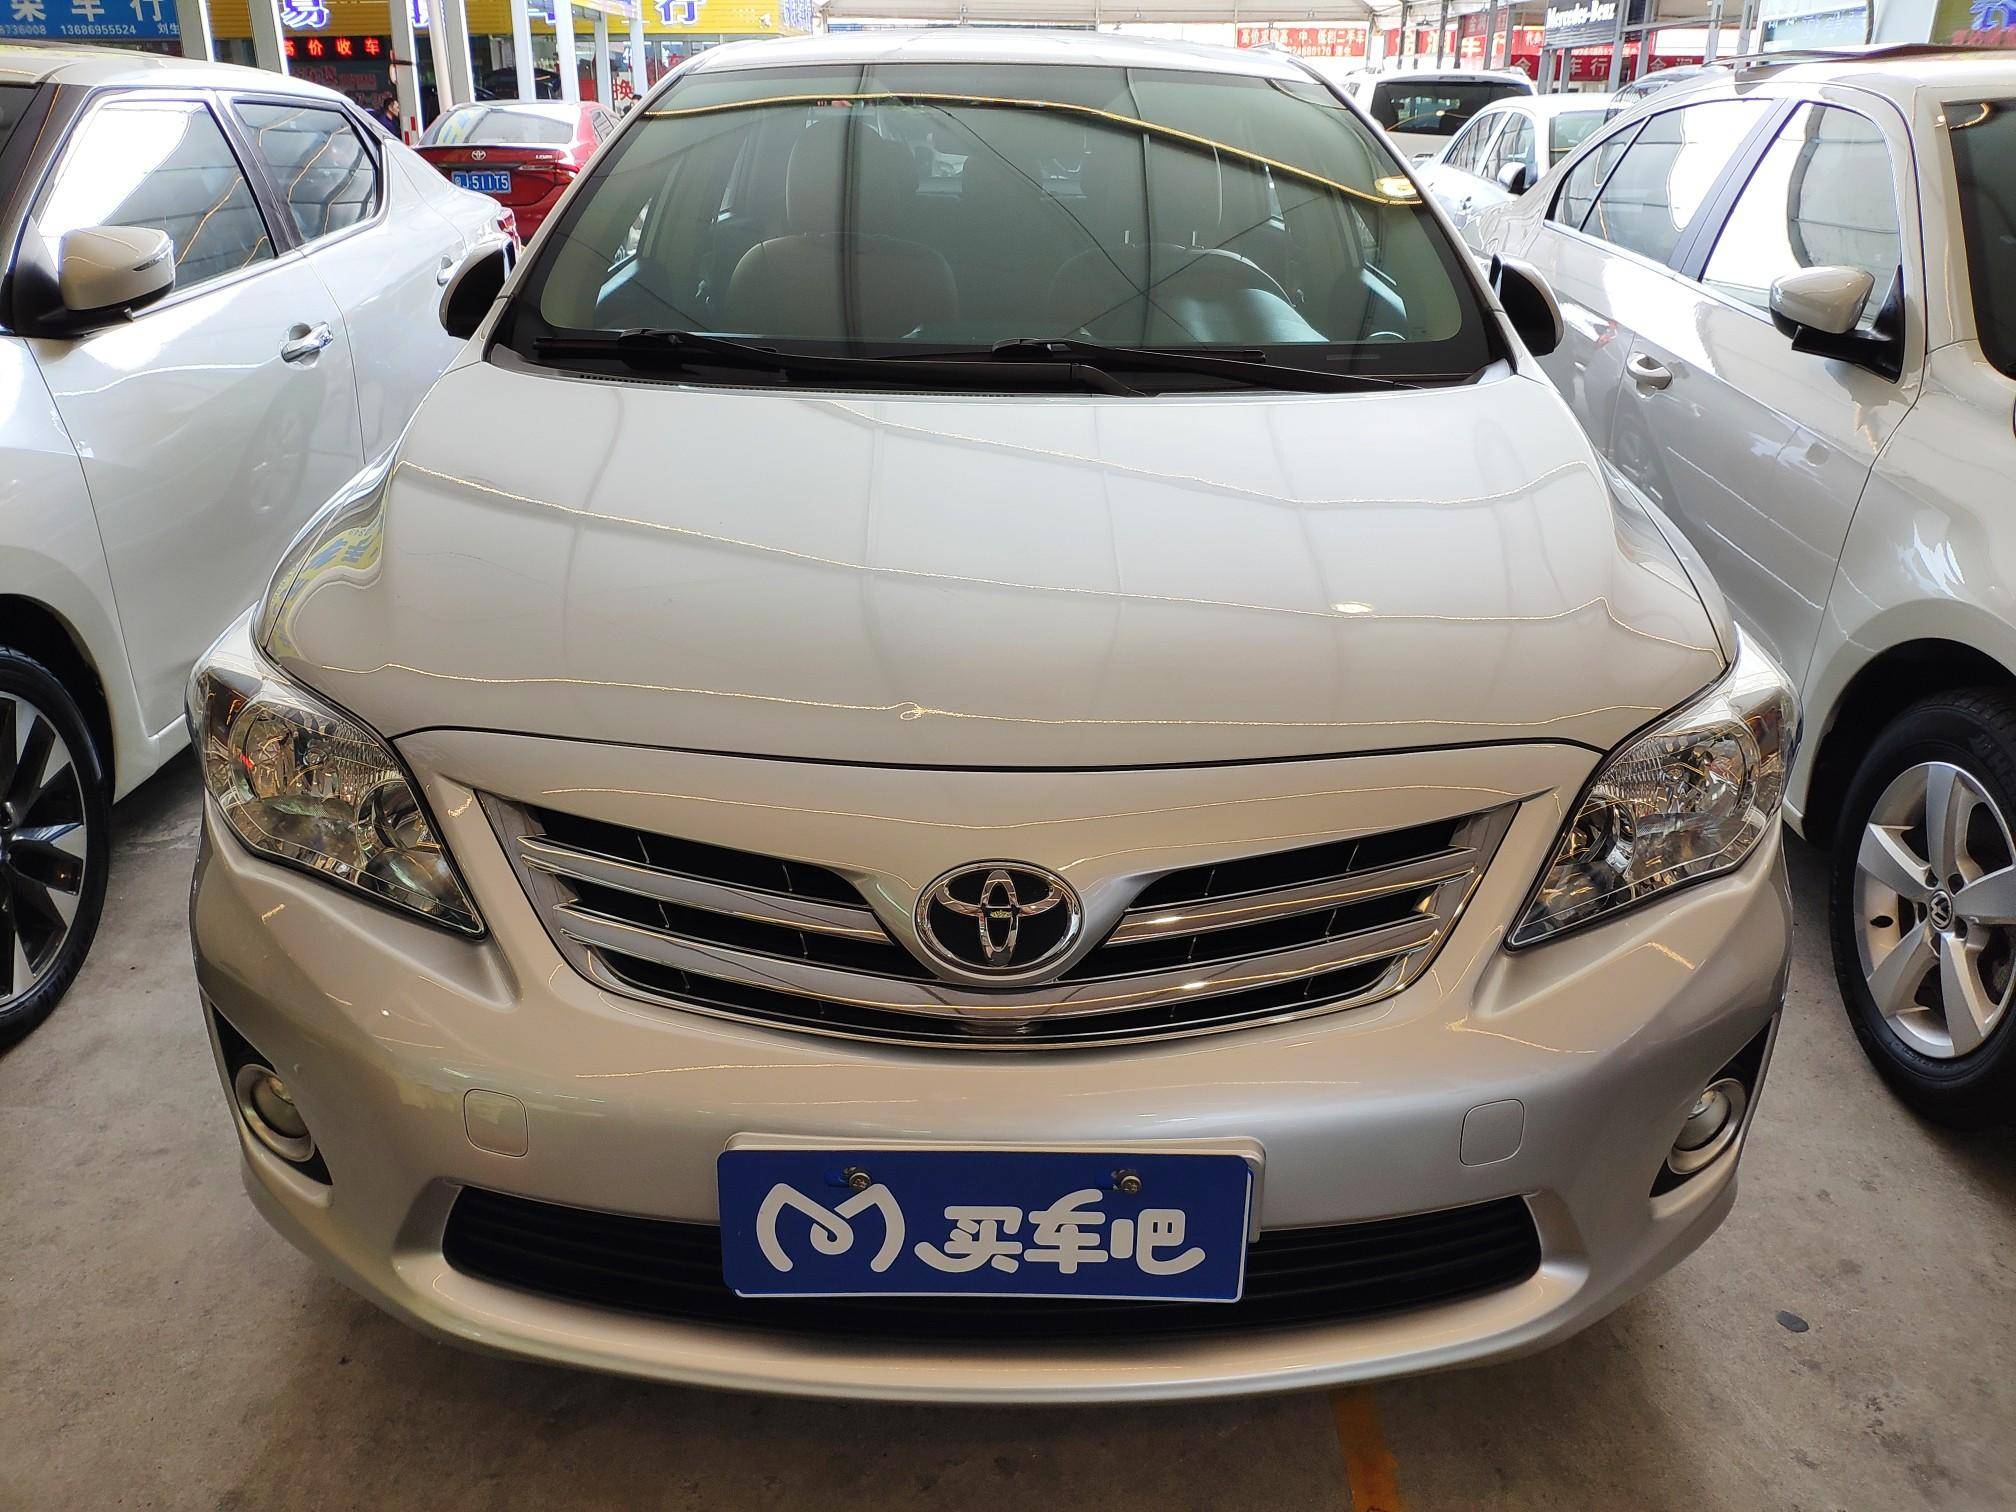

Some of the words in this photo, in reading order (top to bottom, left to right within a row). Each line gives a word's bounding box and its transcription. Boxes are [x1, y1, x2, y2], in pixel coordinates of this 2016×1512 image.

[1547, 2, 1615, 28] Mercedes-Benz
[914, 1188, 1206, 1275] 买车吧
